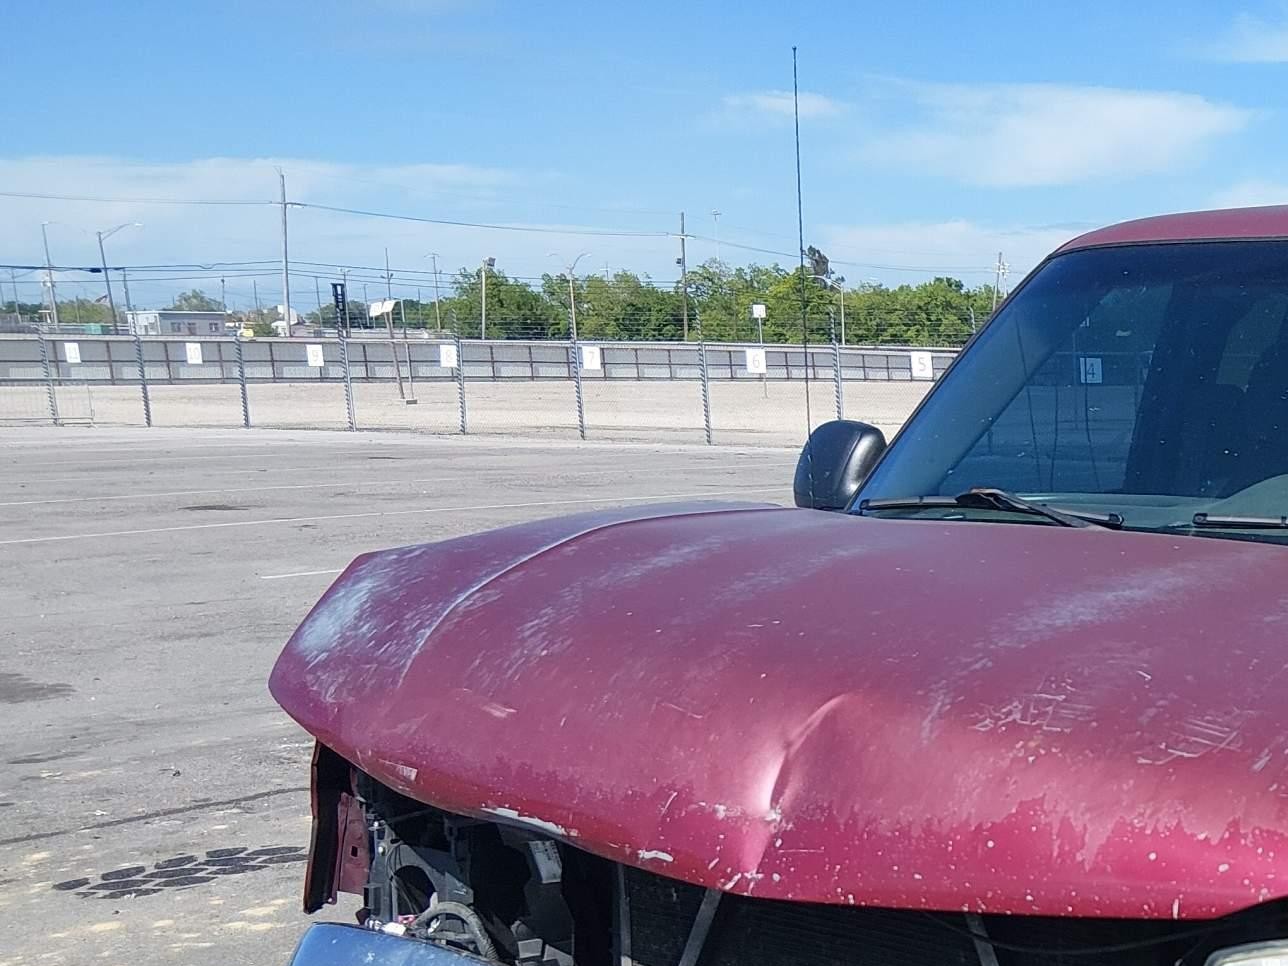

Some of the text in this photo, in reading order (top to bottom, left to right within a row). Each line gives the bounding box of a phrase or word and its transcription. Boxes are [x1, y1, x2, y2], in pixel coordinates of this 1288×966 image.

[752, 353, 761, 368] 6
[918, 356, 927, 372] 5
[1087, 362, 1096, 379] 4
